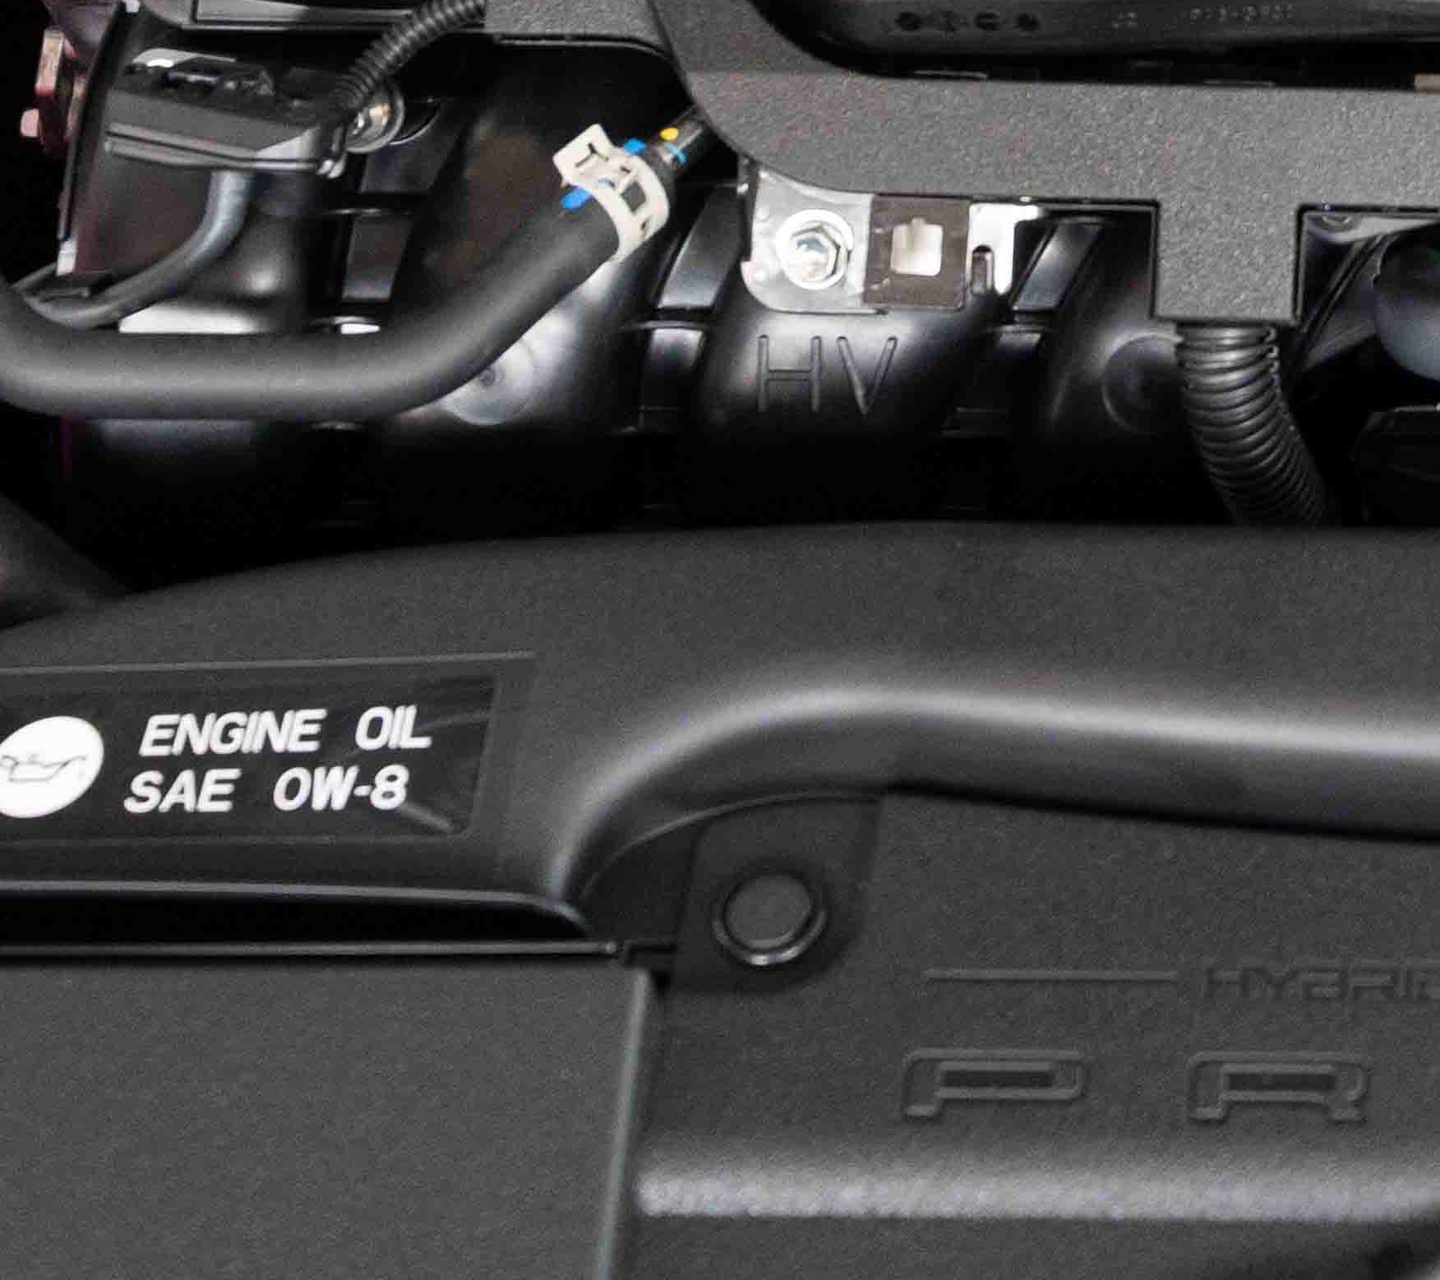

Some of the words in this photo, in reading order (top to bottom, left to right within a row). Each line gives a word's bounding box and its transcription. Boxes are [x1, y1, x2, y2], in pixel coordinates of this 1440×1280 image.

[756, 334, 898, 417] HV
[138, 708, 328, 758] ENGINE
[354, 704, 433, 750] OIL
[123, 768, 242, 814] SAE
